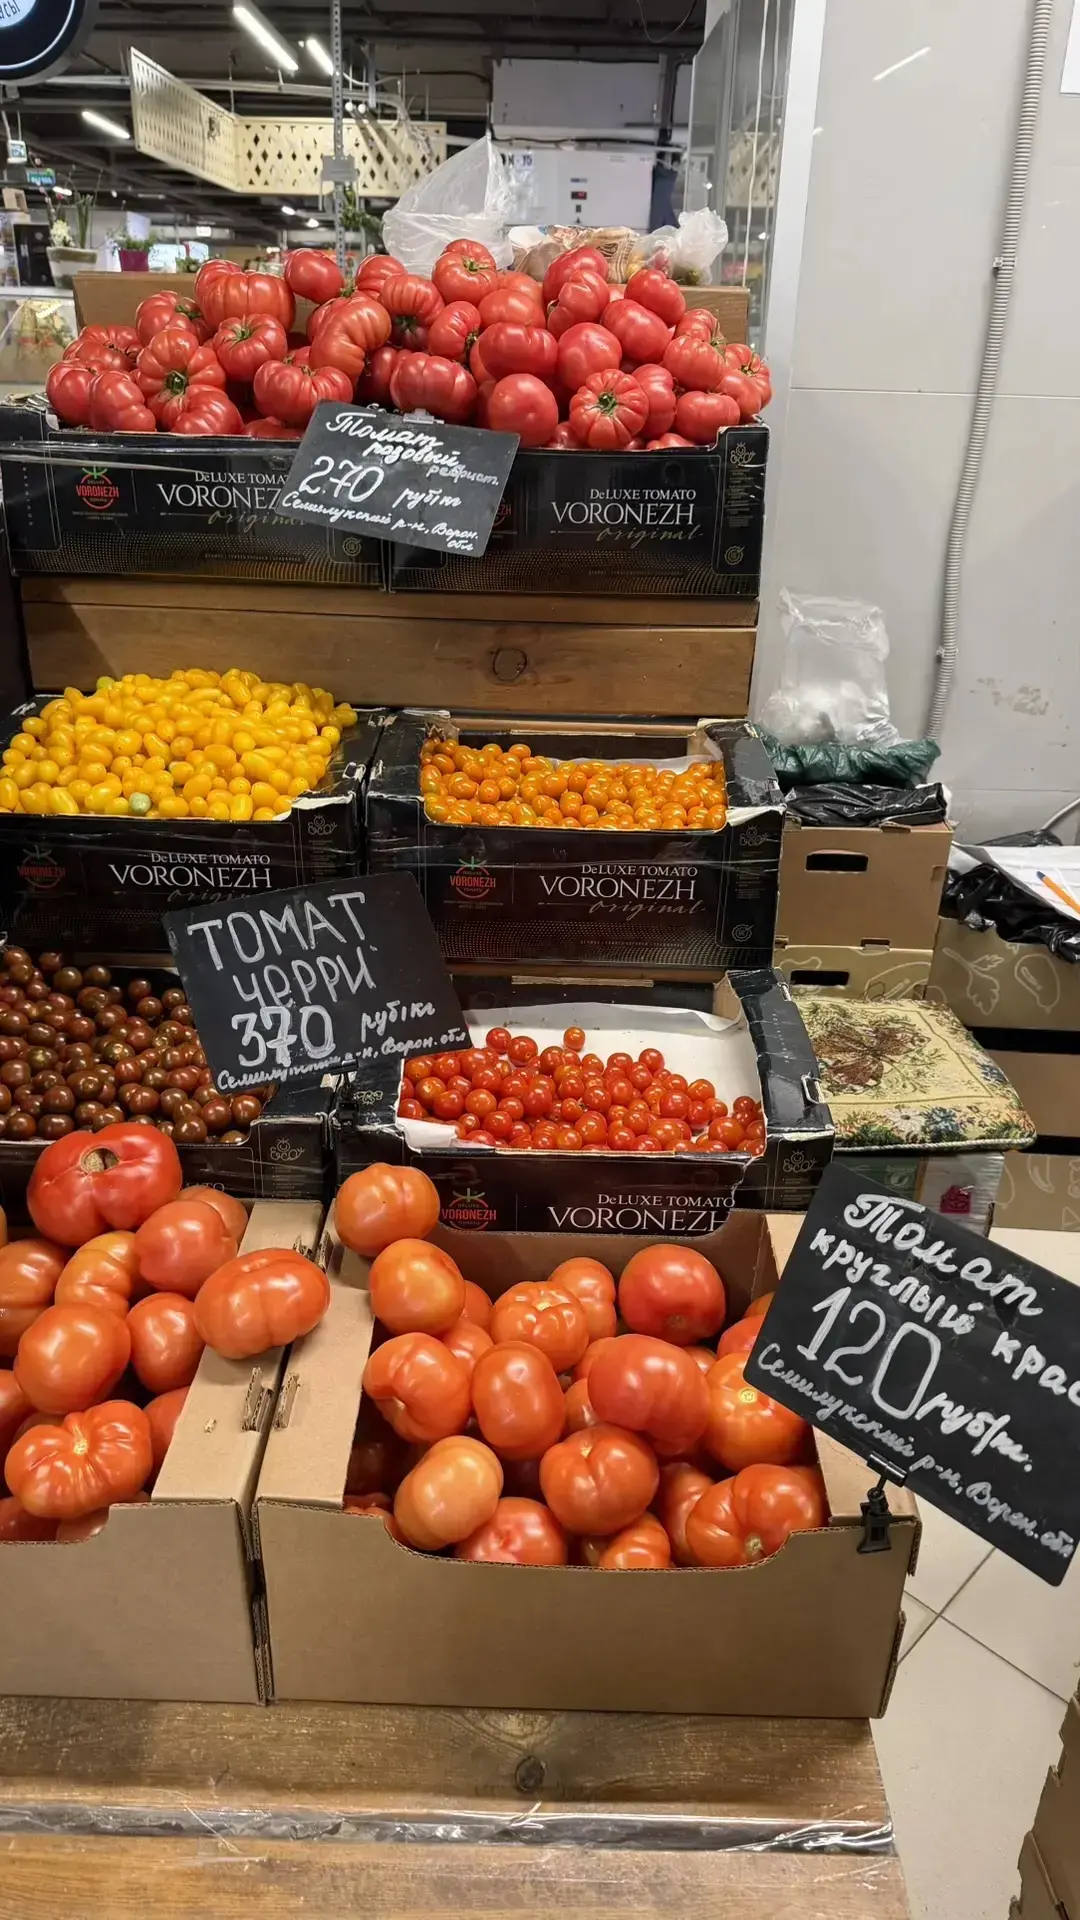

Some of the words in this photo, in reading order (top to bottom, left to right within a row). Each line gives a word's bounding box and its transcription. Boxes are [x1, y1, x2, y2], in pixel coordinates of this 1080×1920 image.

[326, 412, 444, 447] Томат
[75, 484, 120, 498] VORONEZH
[156, 483, 282, 510] VORONEZ
[590, 489, 641, 501] DeLUXE
[643, 489, 696, 501] TOMATO
[550, 501, 695, 526] VORONEZH
[212, 854, 271, 865] TOMATO
[581, 863, 637, 876] DeLUXE
[639, 864, 697, 877] TOMATO
[108, 864, 273, 889] VORONEZH
[449, 875, 496, 888] VORONEZH
[539, 875, 696, 901] VORONEZH
[186, 892, 366, 970] ТОМАТ
[231, 1004, 336, 1067] 370
[597, 1193, 662, 1207] DeLUXE
[666, 1195, 736, 1208] TOMATO
[440, 1207, 497, 1221] VORONEZH
[843, 1194, 1044, 1317] Томат
[797, 1286, 942, 1420] 120
